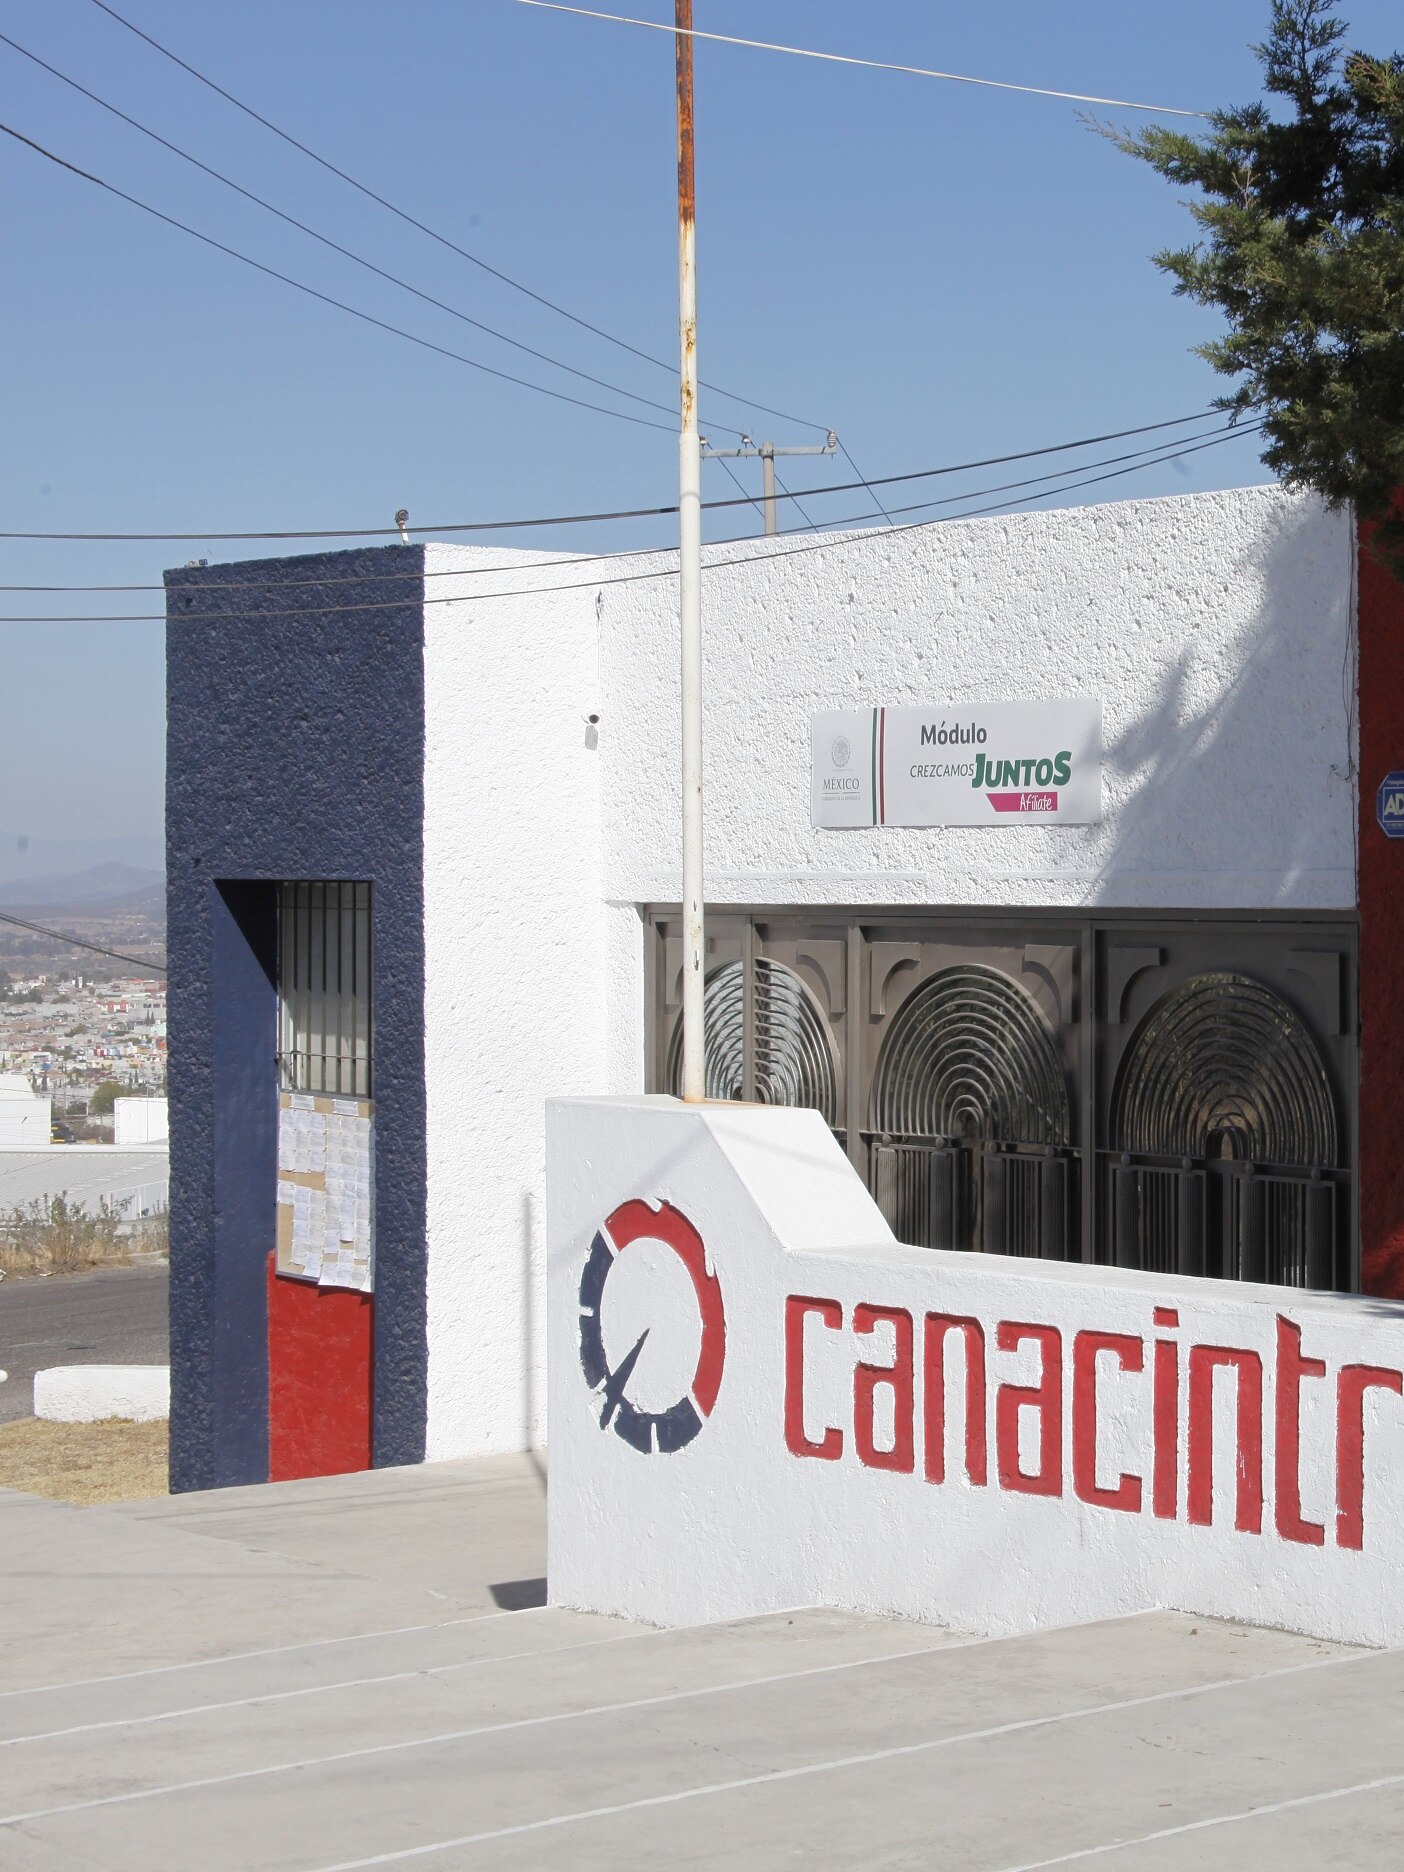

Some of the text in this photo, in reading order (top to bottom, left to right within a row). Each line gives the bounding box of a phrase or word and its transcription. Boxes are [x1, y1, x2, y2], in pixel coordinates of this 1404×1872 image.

[920, 721, 987, 745] Módulo
[910, 763, 974, 778] CREZCAMOS
[823, 776, 860, 790] MÉXICO
